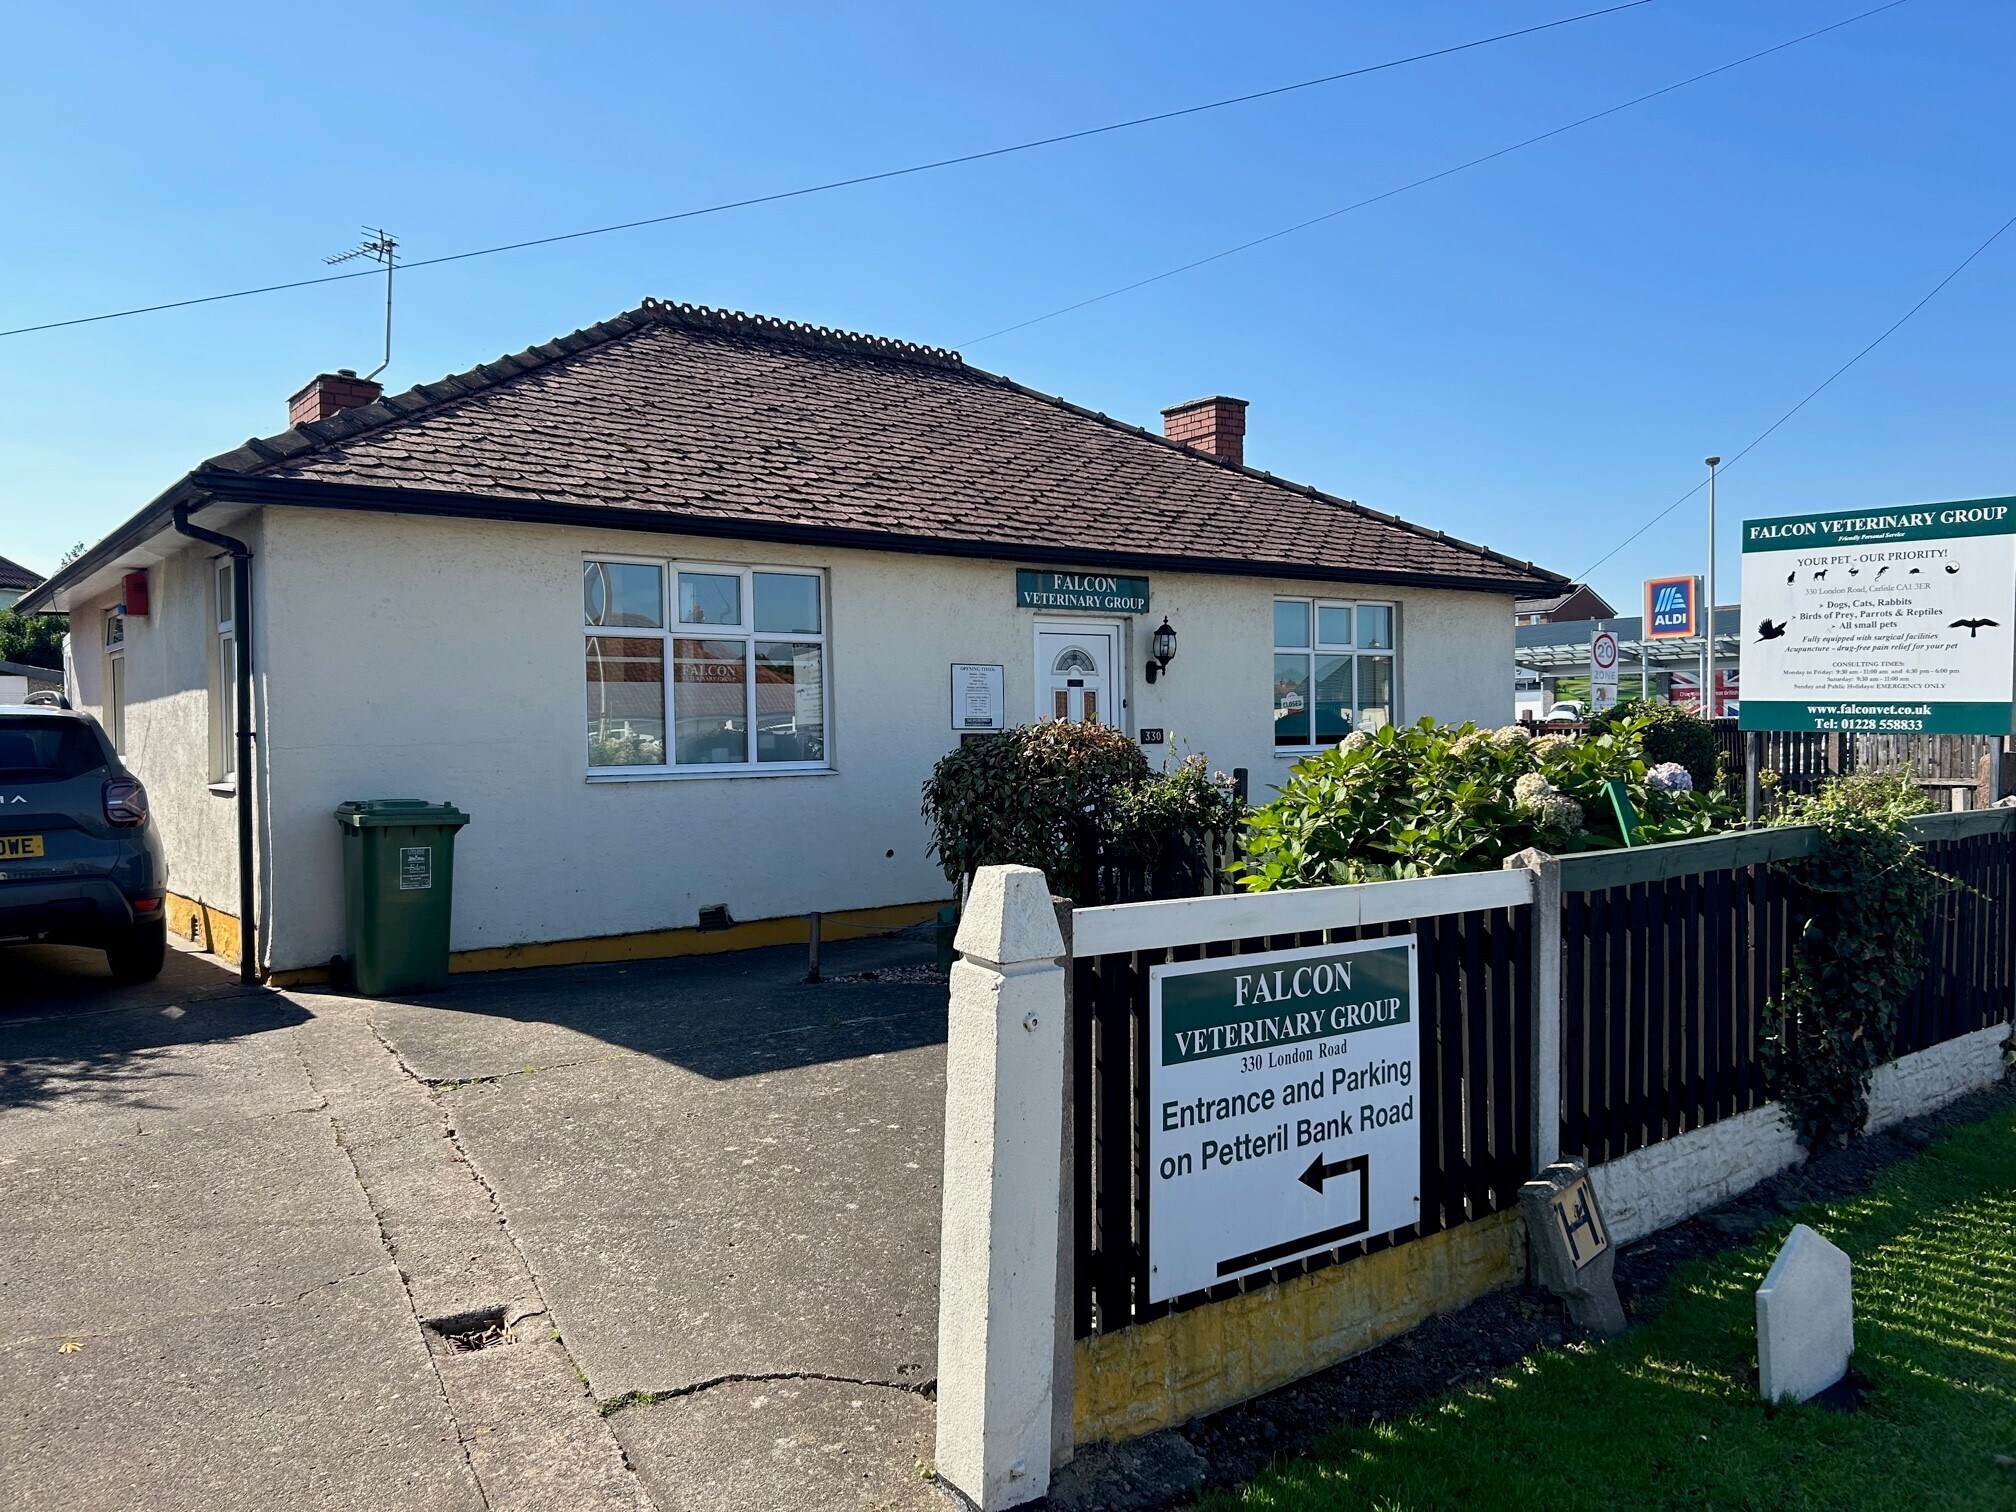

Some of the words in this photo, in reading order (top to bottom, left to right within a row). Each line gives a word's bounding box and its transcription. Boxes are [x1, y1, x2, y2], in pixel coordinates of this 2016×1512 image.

[1750, 522, 1816, 539] FALCON
[1820, 512, 1936, 533] VETERINARY
[1940, 506, 2008, 524] GROUP
[1838, 534, 1860, 542] Friendly
[1861, 532, 1885, 540] Personal
[1798, 557, 1828, 566] YOUR
[1831, 555, 1851, 564] PET
[1860, 553, 1885, 562] OUR
[1889, 549, 1948, 560] PRIORITY!
[1054, 574, 1117, 592] FALCON
[1869, 584, 1895, 592] Carlisle
[1024, 592, 1102, 607] VETERINARY
[1105, 597, 1144, 609] GROUP
[1827, 601, 1850, 610] Dogs,
[1878, 598, 1912, 606] Rabbits
[1655, 613, 1686, 625] ALDI
[1835, 612, 1857, 620] Prey,
[1907, 608, 1943, 617] Reptiles
[1880, 621, 1897, 629] pets
[1822, 635, 1855, 643] equipped
[1904, 633, 1938, 641] facilities
[1598, 644, 1613, 658] 20
[1836, 644, 1871, 652] drug-free
[1872, 644, 1888, 652] pain
[1891, 643, 1911, 651] relief
[1911, 643, 1924, 651] for
[683, 665, 736, 676] FALCON
[1595, 671, 1615, 679] ZONE
[1283, 700, 1302, 708] CLOSED
[1807, 704, 1932, 715] www.falconvet.co.uk
[1815, 719, 1838, 729] Tel:
[1841, 719, 1876, 729] 01228
[1879, 719, 1922, 730] 558833
[1145, 732, 1161, 741] 330
[1234, 961, 1352, 1008] FALCON
[1175, 1009, 1325, 1056] VETERINARY
[1330, 998, 1400, 1030] GROUP
[1240, 1055, 1262, 1074] 330
[1268, 1047, 1312, 1069] London
[1319, 1039, 1347, 1059] Road
[1162, 1088, 1274, 1131] Entrance
[1283, 1072, 1324, 1106] and
[1332, 1059, 1411, 1095] Parking
[1160, 1152, 1192, 1180] on
[1202, 1125, 1288, 1170] Petteril
[1297, 1111, 1353, 1147] Bank
[1361, 1095, 1414, 1131] Road
[1558, 1188, 1600, 1261] H
